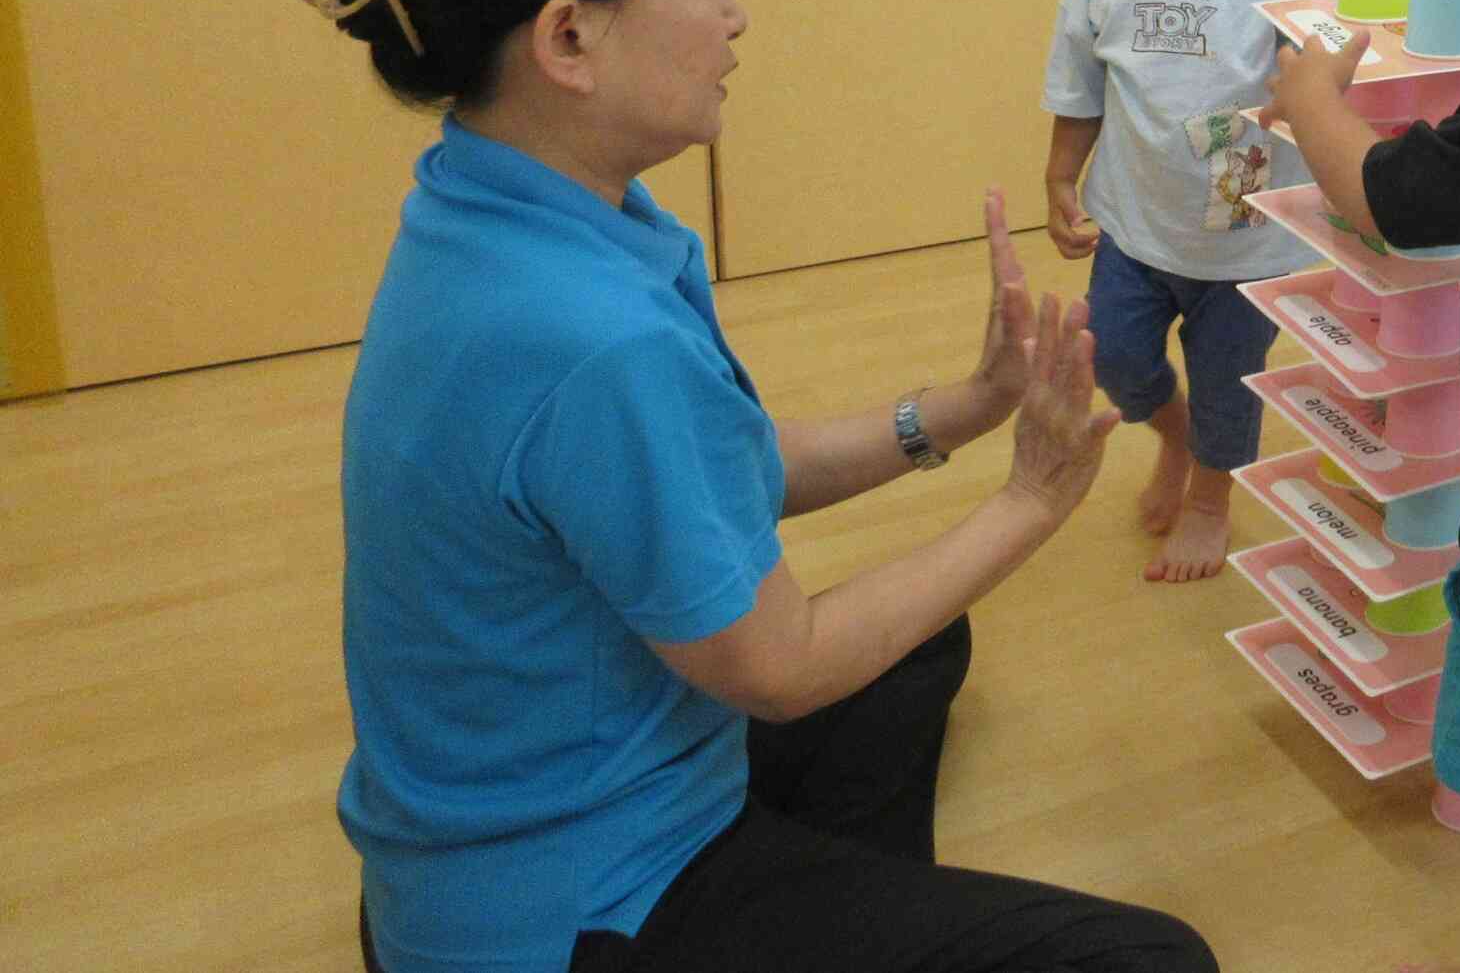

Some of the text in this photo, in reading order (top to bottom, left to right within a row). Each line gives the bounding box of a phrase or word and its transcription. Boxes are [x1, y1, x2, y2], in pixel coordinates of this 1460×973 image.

[1134, 2, 1219, 38] TOY
[1309, 315, 1352, 346] apple
[1305, 397, 1386, 455] pineapple
[1308, 501, 1359, 540] melon
[1297, 586, 1357, 639] banana
[1297, 668, 1359, 716] grapes
